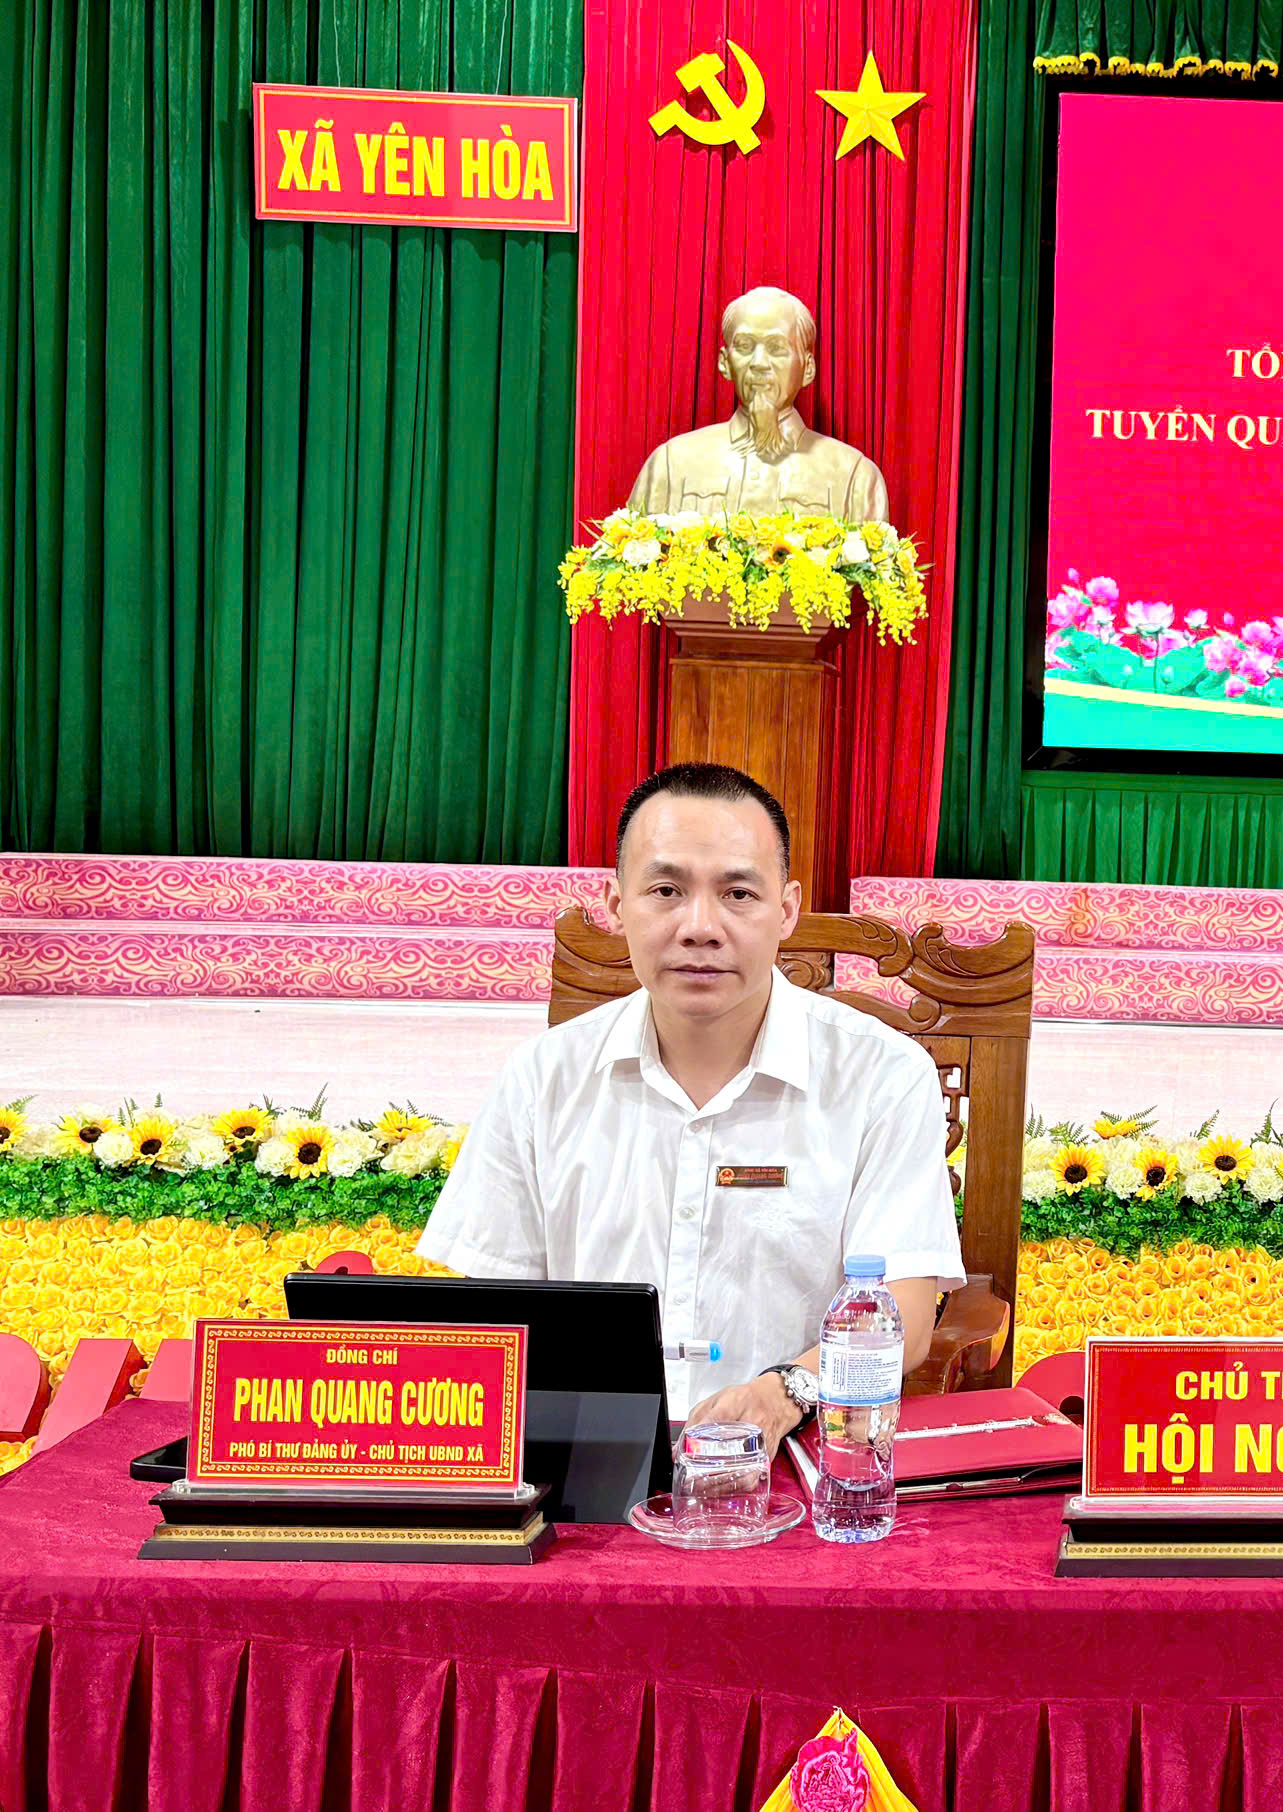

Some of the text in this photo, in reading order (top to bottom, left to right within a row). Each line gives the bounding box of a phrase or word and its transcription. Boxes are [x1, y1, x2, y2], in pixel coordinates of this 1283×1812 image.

[277, 118, 555, 201] XÃ YÊN HÒA
[1085, 405, 1217, 442] TUYỂN
[325, 1343, 398, 1365] ĐỒNG CHÍ
[1175, 1360, 1249, 1401] CHỦ
[233, 1377, 485, 1429] PHAN QUANG CƯƠNG
[229, 1439, 256, 1458] PHÓ
[258, 1439, 273, 1458] BÍ
[274, 1441, 302, 1459] THƯ
[302, 1438, 338, 1459] ĐẢNG
[340, 1439, 358, 1460] ỦY
[369, 1439, 395, 1461] CHỦ
[397, 1445, 427, 1464] TỊCH
[429, 1445, 464, 1461] UBND
[466, 1443, 484, 1462] XÃ
[1123, 1412, 1214, 1485] HỘI
